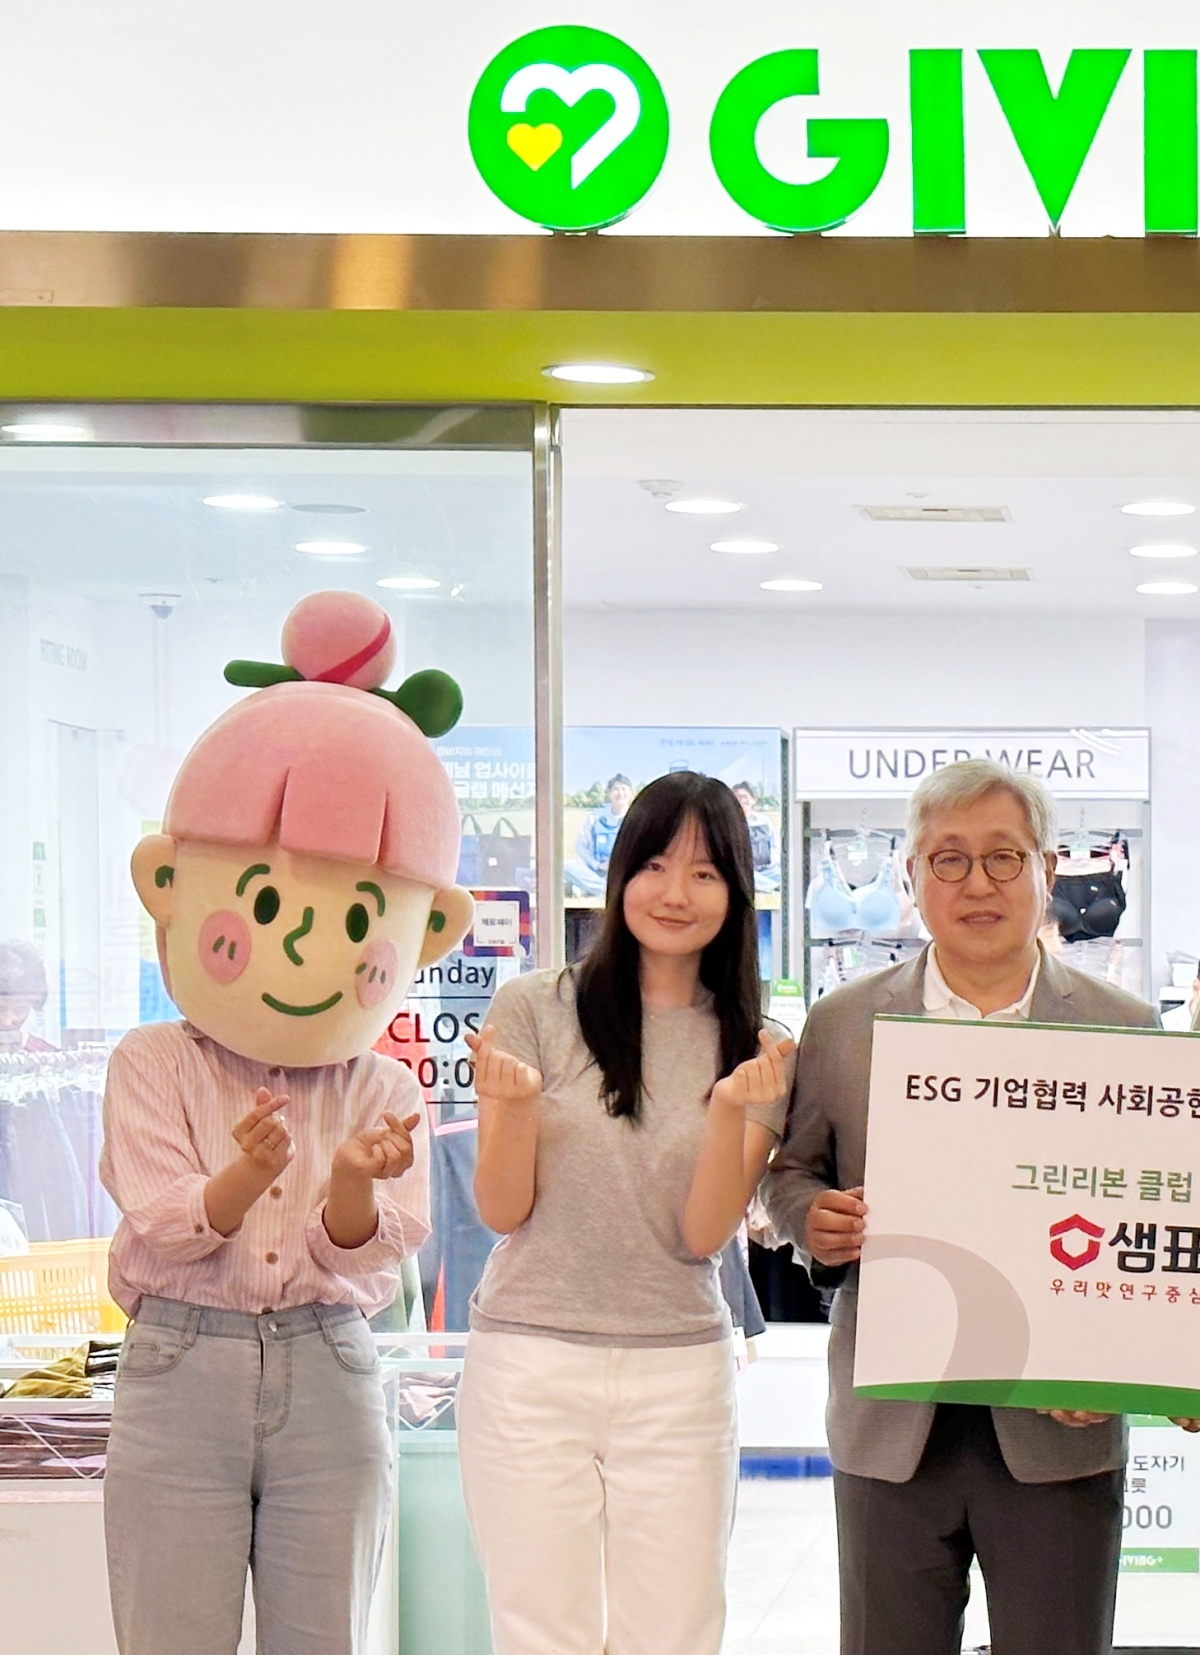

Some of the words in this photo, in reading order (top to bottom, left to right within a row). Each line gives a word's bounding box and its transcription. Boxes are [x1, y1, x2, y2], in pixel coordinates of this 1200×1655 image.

[905, 1074, 962, 1102] ESG
[974, 1077, 1087, 1112] 기업협력
[1011, 1164, 1128, 1198] 그린리본
[1136, 1170, 1192, 1203] 클럽
[1132, 1455, 1185, 1472] 도자기
